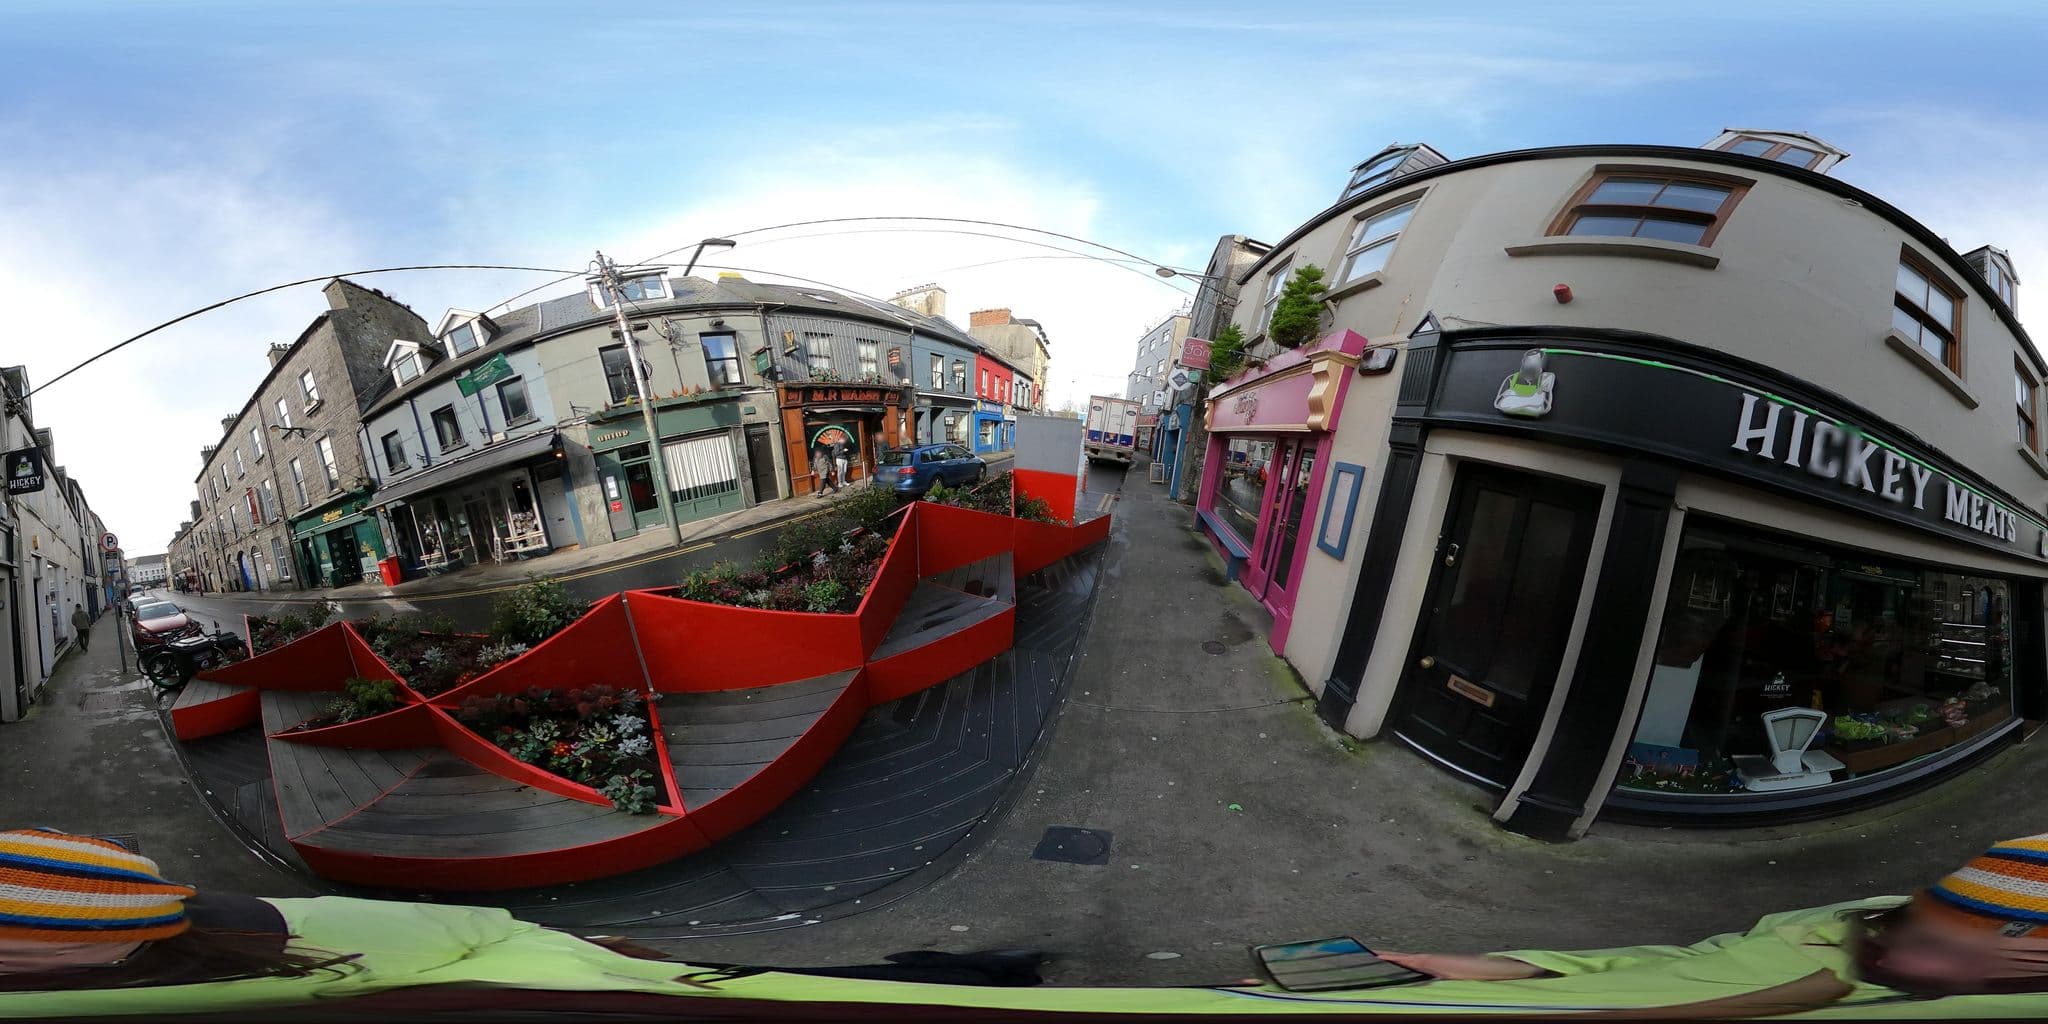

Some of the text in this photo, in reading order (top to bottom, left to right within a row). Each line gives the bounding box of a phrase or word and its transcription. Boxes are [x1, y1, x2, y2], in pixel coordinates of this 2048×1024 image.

[1731, 392, 2017, 543] HICKEY MEATS
[10, 476, 41, 489] HICKEY
[106, 535, 114, 547] P
[1764, 684, 1791, 692] HICKEY
